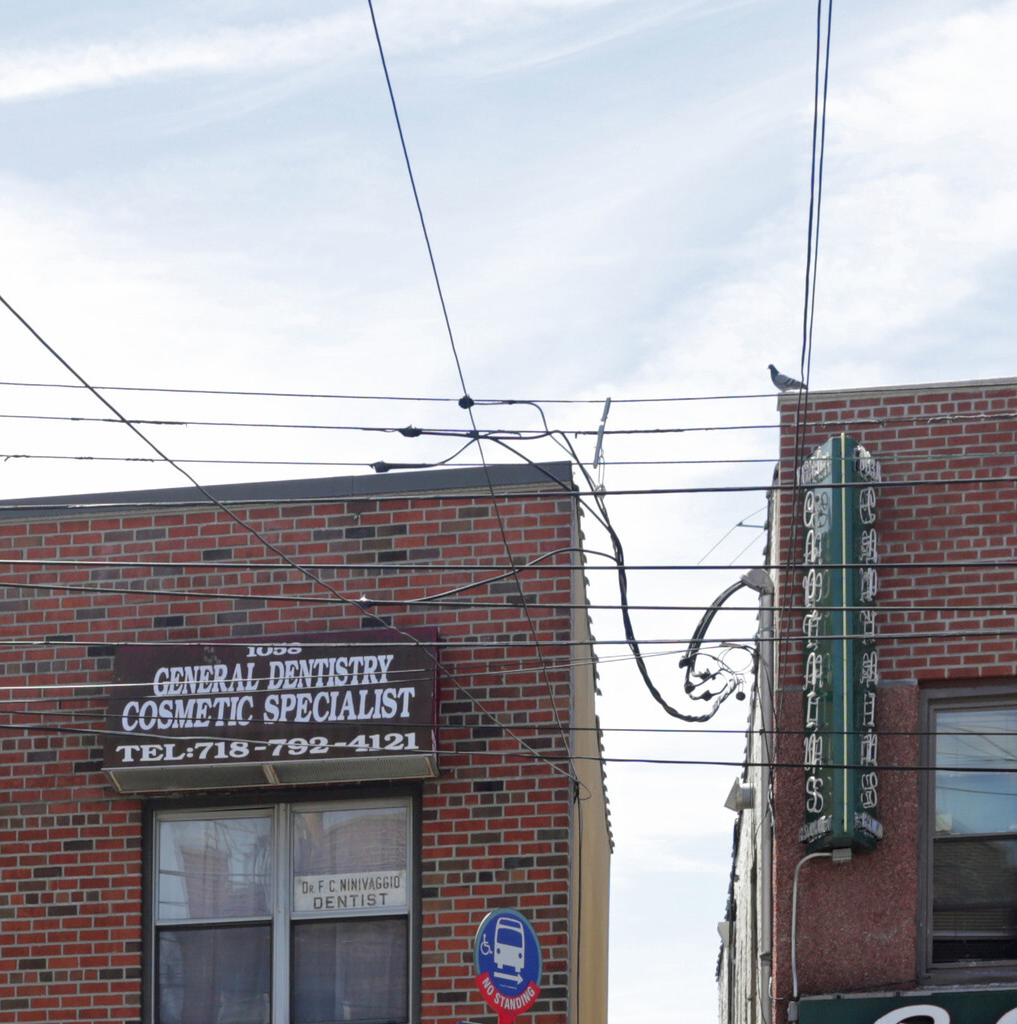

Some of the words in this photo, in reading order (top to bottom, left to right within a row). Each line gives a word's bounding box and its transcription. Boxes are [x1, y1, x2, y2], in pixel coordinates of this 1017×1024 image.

[246, 642, 303, 658] 1058
[152, 662, 259, 697] GENERAL
[267, 654, 394, 690] DENTISTRY
[121, 695, 254, 732] COSMETIC
[262, 687, 415, 725] SPECIALIST
[340, 875, 401, 891] NINIVAGGIO
[313, 893, 389, 910] DENTIST
[481, 976, 494, 995] NO
[494, 985, 536, 1010] STANDING
